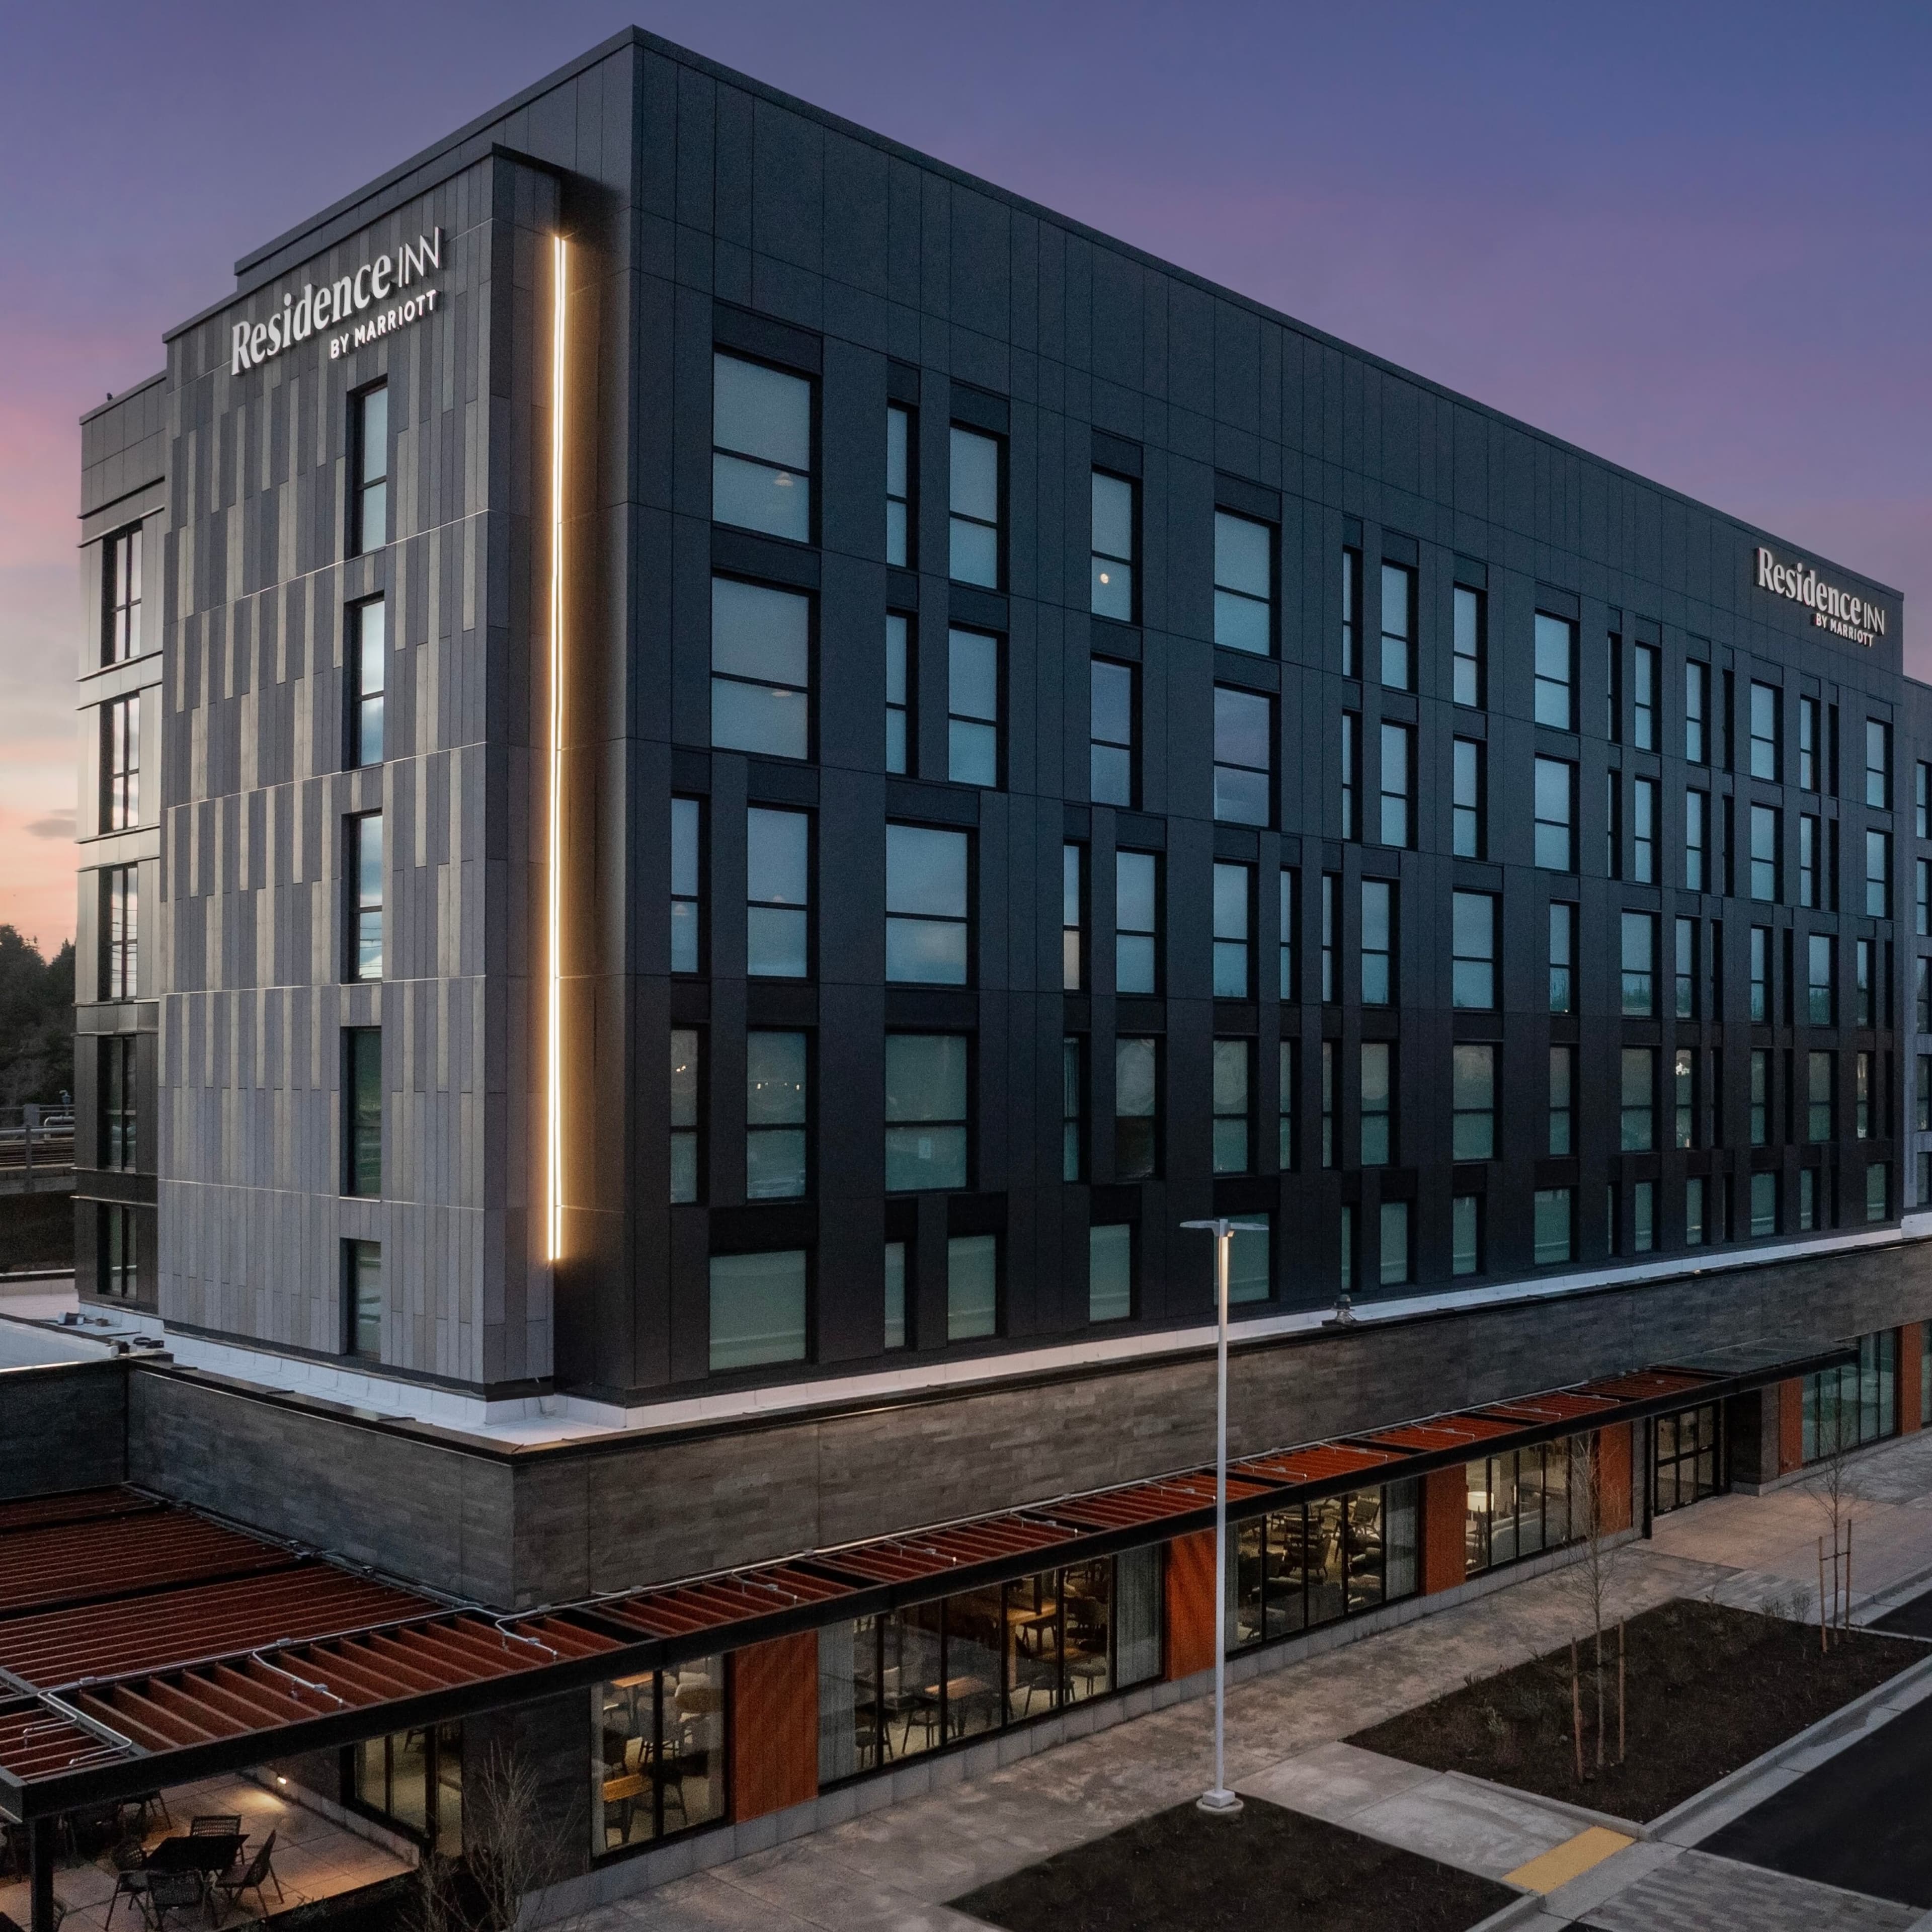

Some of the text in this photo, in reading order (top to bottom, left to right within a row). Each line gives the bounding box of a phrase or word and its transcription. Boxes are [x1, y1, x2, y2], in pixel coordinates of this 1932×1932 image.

[231, 226, 440, 375] Residence INN
[330, 289, 437, 359] BY MARRIOTT
[1758, 547, 1885, 635] Residence INN
[1815, 612, 1874, 647] BY MARRIOTT
